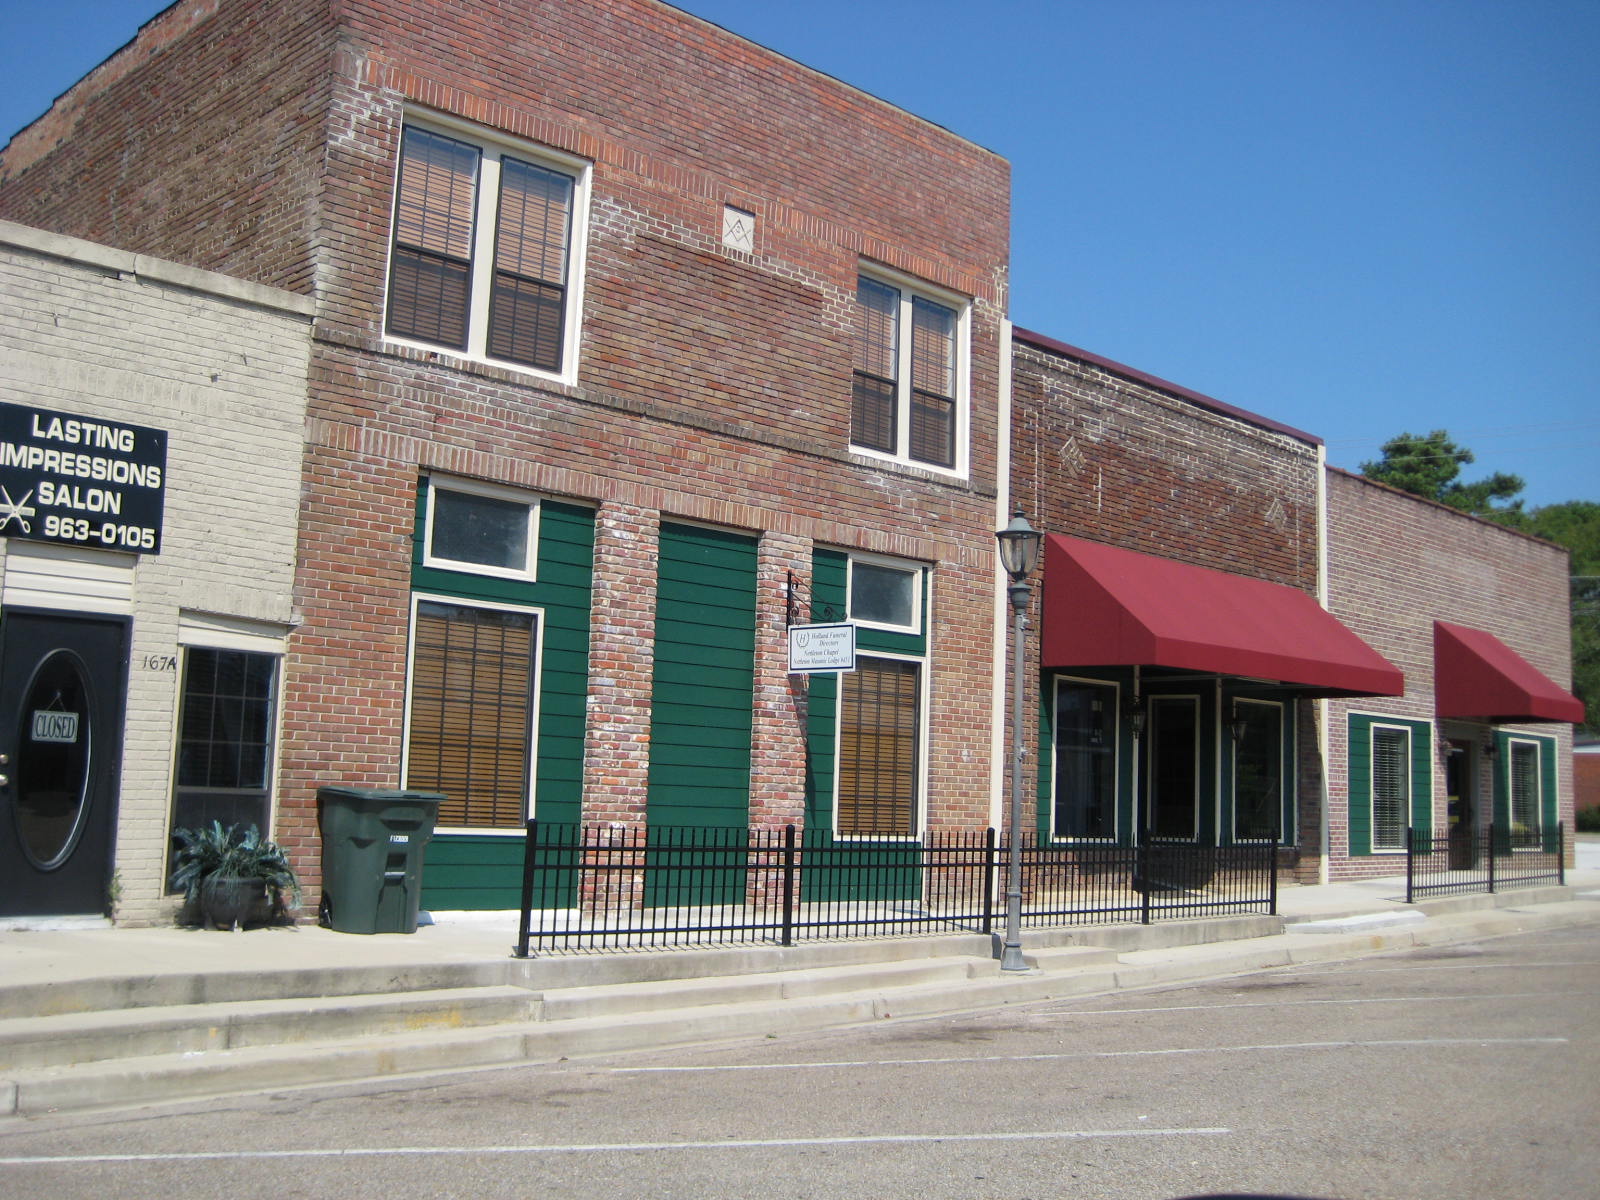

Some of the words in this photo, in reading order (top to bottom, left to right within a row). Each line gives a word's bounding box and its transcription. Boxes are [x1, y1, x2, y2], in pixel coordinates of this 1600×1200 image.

[32, 414, 135, 453] LASTING
[0, 442, 162, 489] IMPRESSIONS
[38, 481, 122, 515] SALON
[44, 515, 156, 549] 963-0105
[142, 655, 177, 671] 167A
[35, 714, 76, 739] CLOSED
